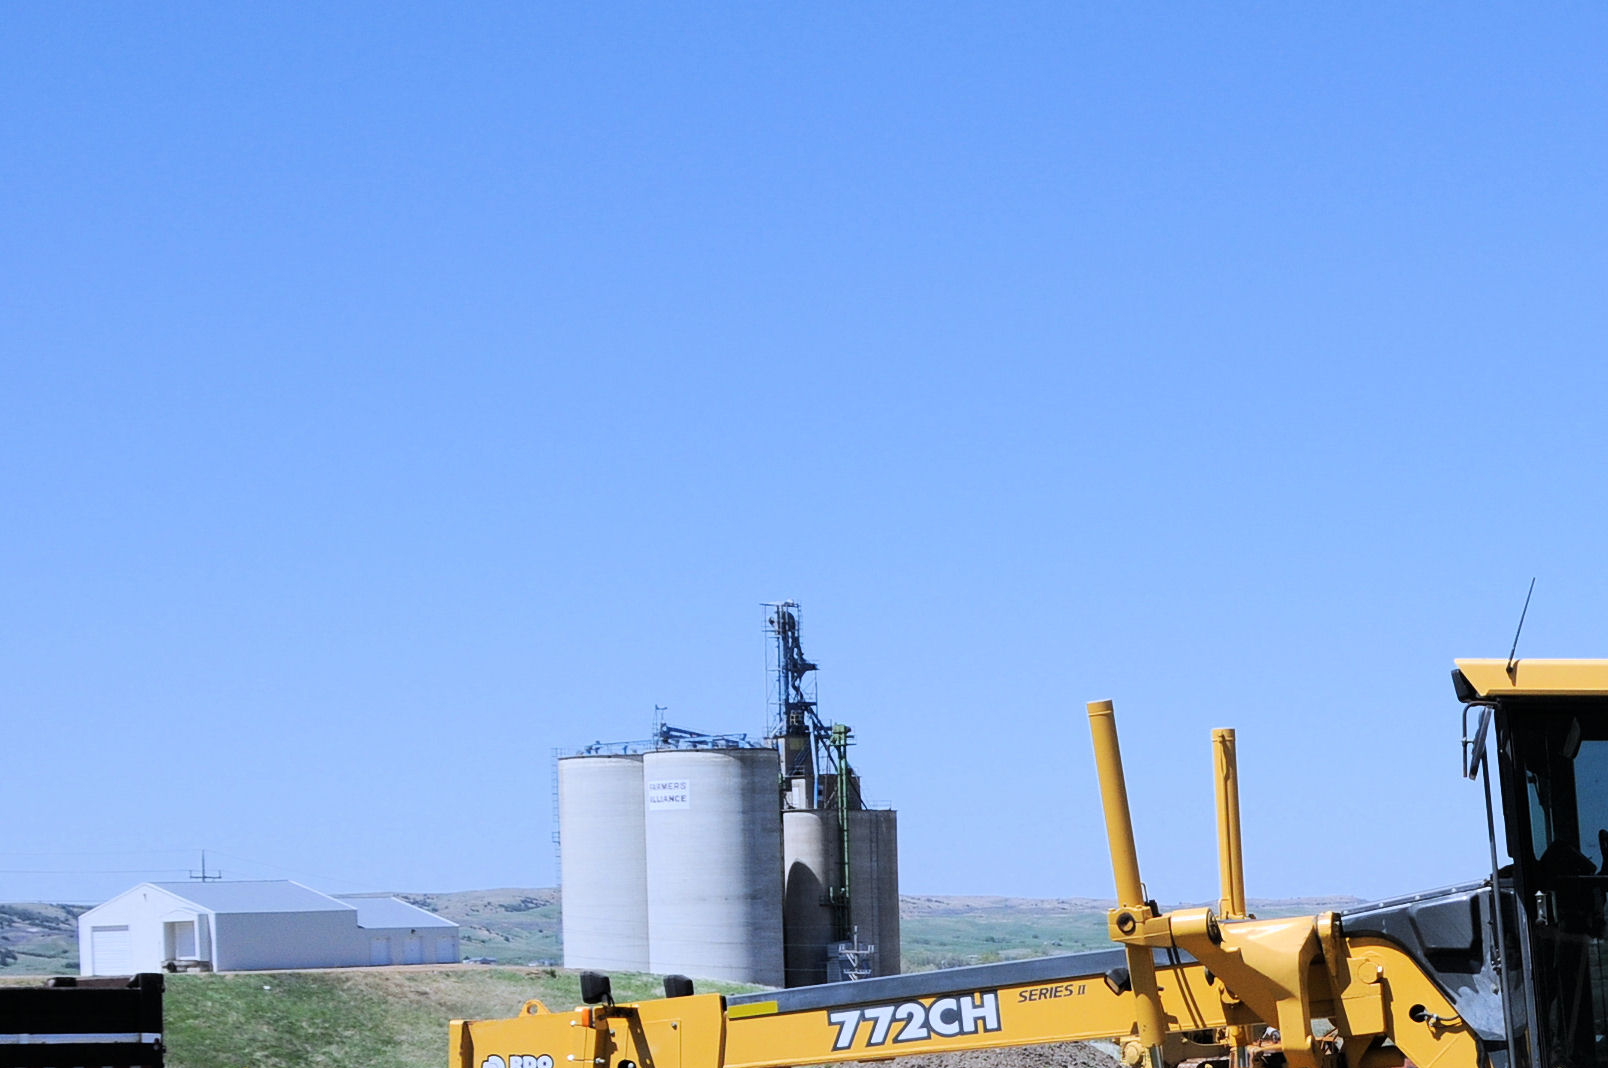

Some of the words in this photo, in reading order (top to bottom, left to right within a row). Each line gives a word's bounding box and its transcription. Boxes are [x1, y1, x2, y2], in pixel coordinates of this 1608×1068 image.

[829, 992, 1000, 1050] 772CH
[1018, 984, 1073, 1003] SERIES
[1077, 984, 1086, 996] II
